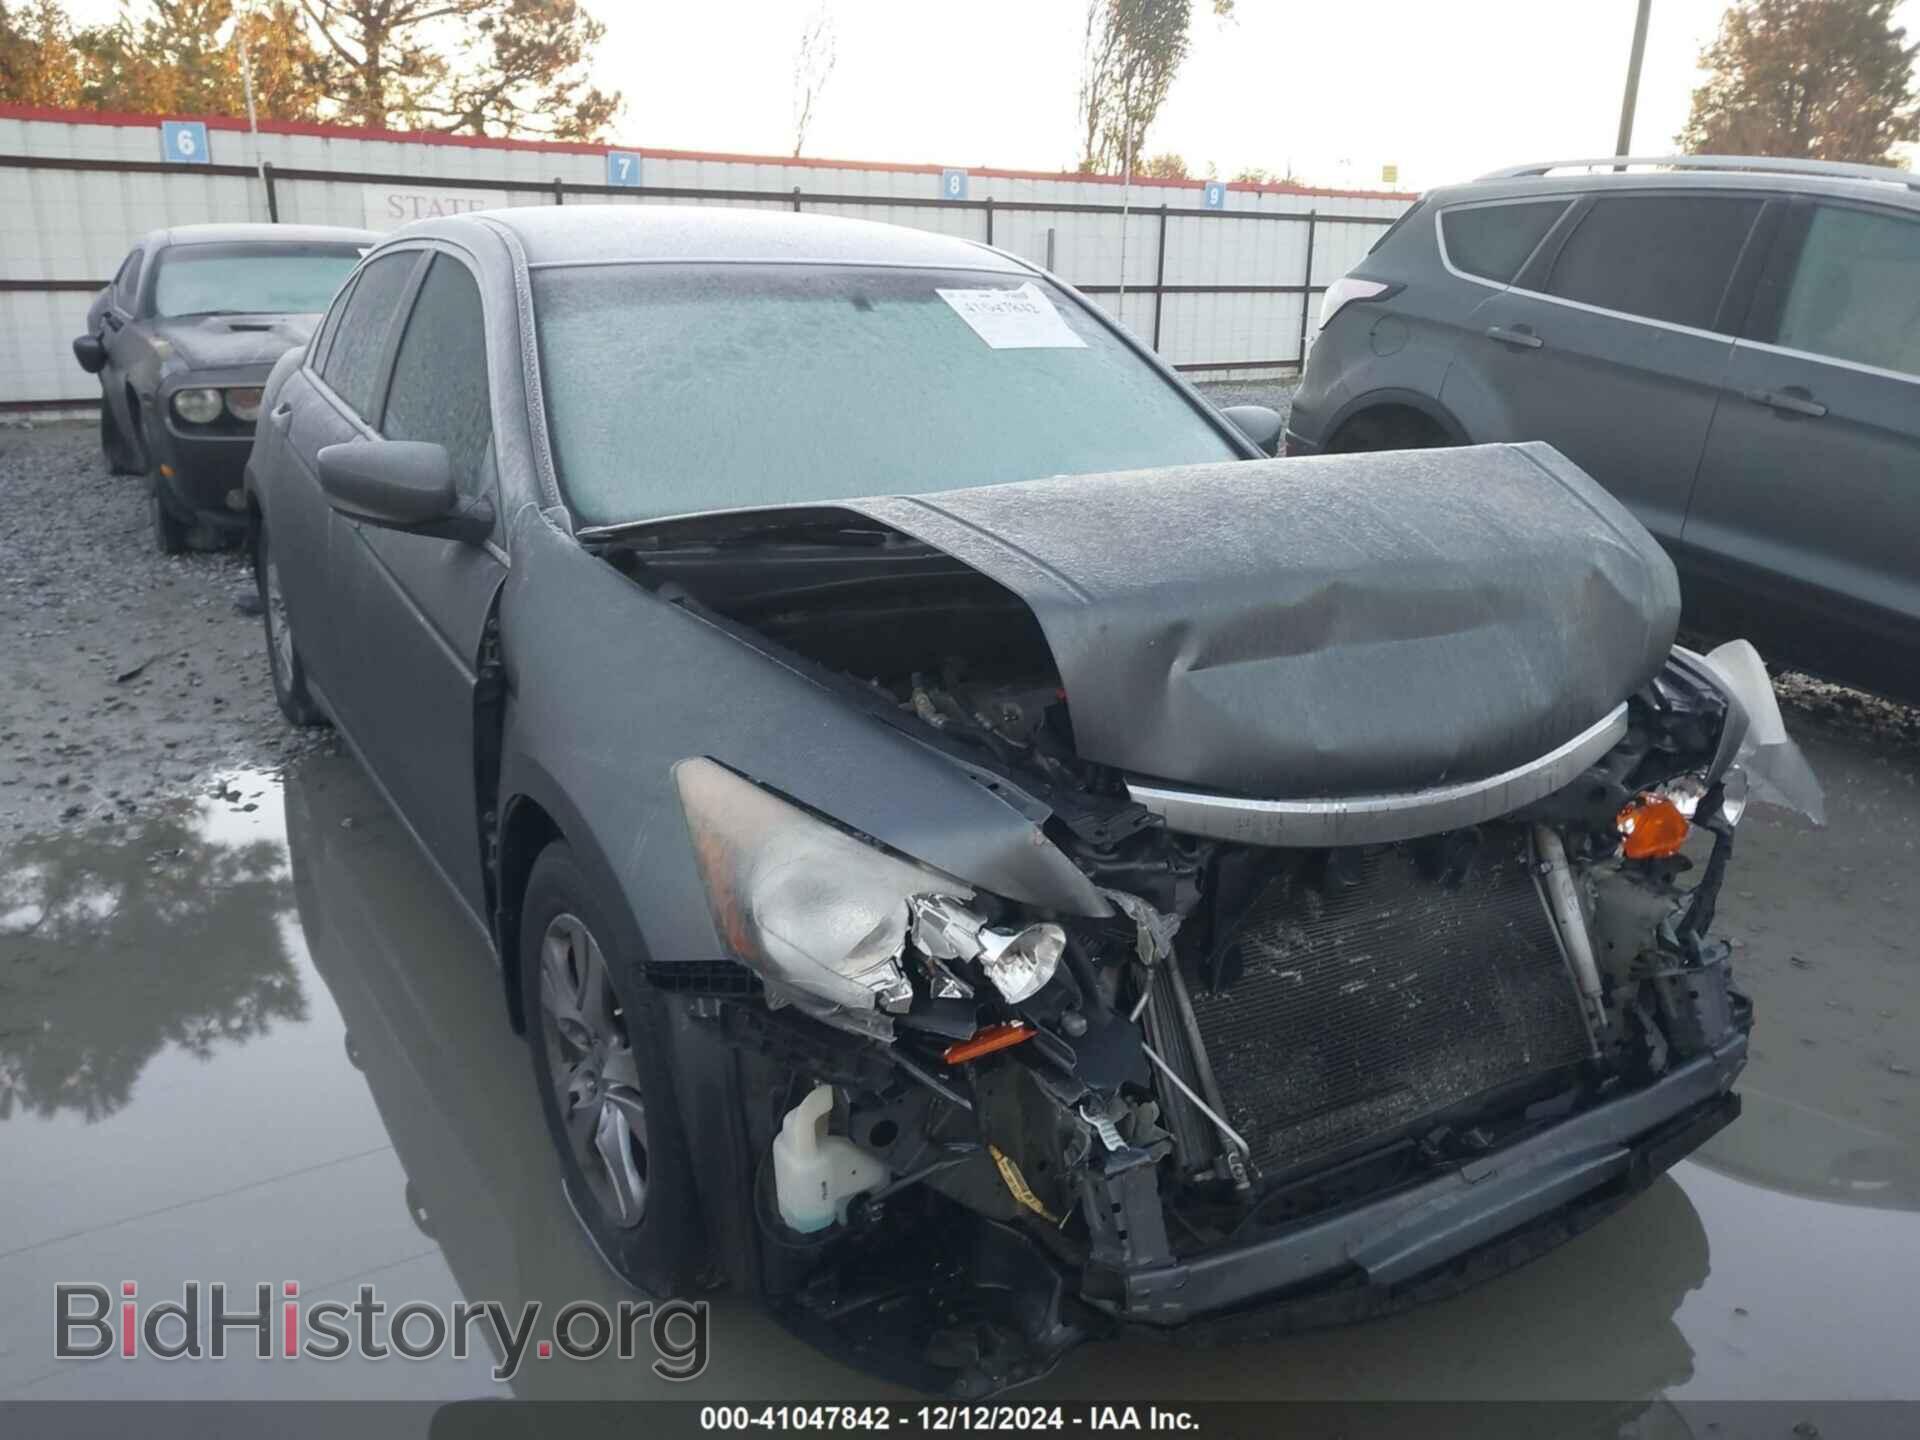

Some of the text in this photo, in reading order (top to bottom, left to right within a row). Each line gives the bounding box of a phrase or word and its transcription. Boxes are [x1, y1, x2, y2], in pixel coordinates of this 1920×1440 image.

[177, 129, 196, 155] 6
[618, 158, 631, 180] 7
[950, 174, 961, 195] 8
[1209, 187, 1219, 205] 9
